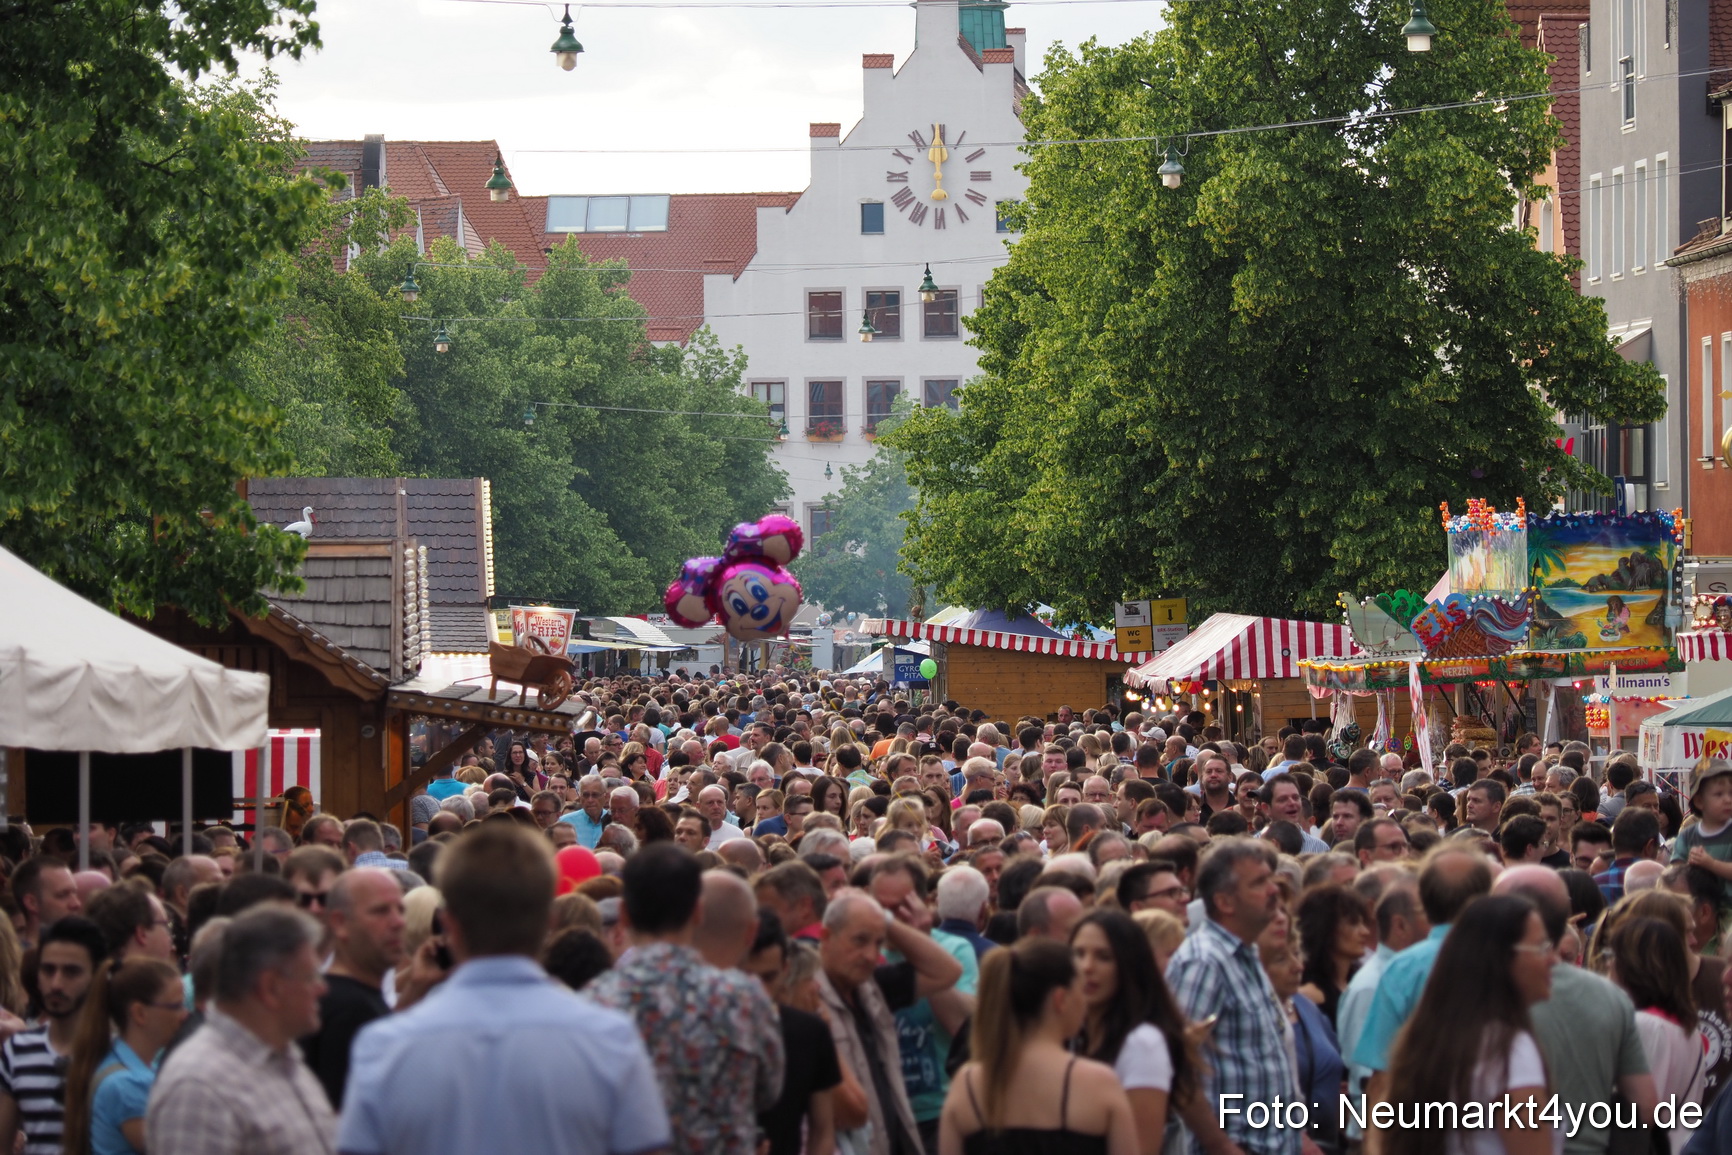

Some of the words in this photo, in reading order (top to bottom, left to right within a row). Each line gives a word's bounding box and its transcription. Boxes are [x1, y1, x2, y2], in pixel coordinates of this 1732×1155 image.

[892, 148, 914, 165] X
[964, 147, 986, 163] II
[886, 170, 908, 182] IX
[969, 170, 992, 181] III
[954, 202, 970, 224] V
[535, 616, 562, 626] Western
[531, 623, 565, 637] FRIES
[899, 665, 921, 673] GYRO
[1442, 666, 1473, 677] HERZEN
[1602, 675, 1671, 689] Kllmann's
[1681, 732, 1732, 760] Wes
